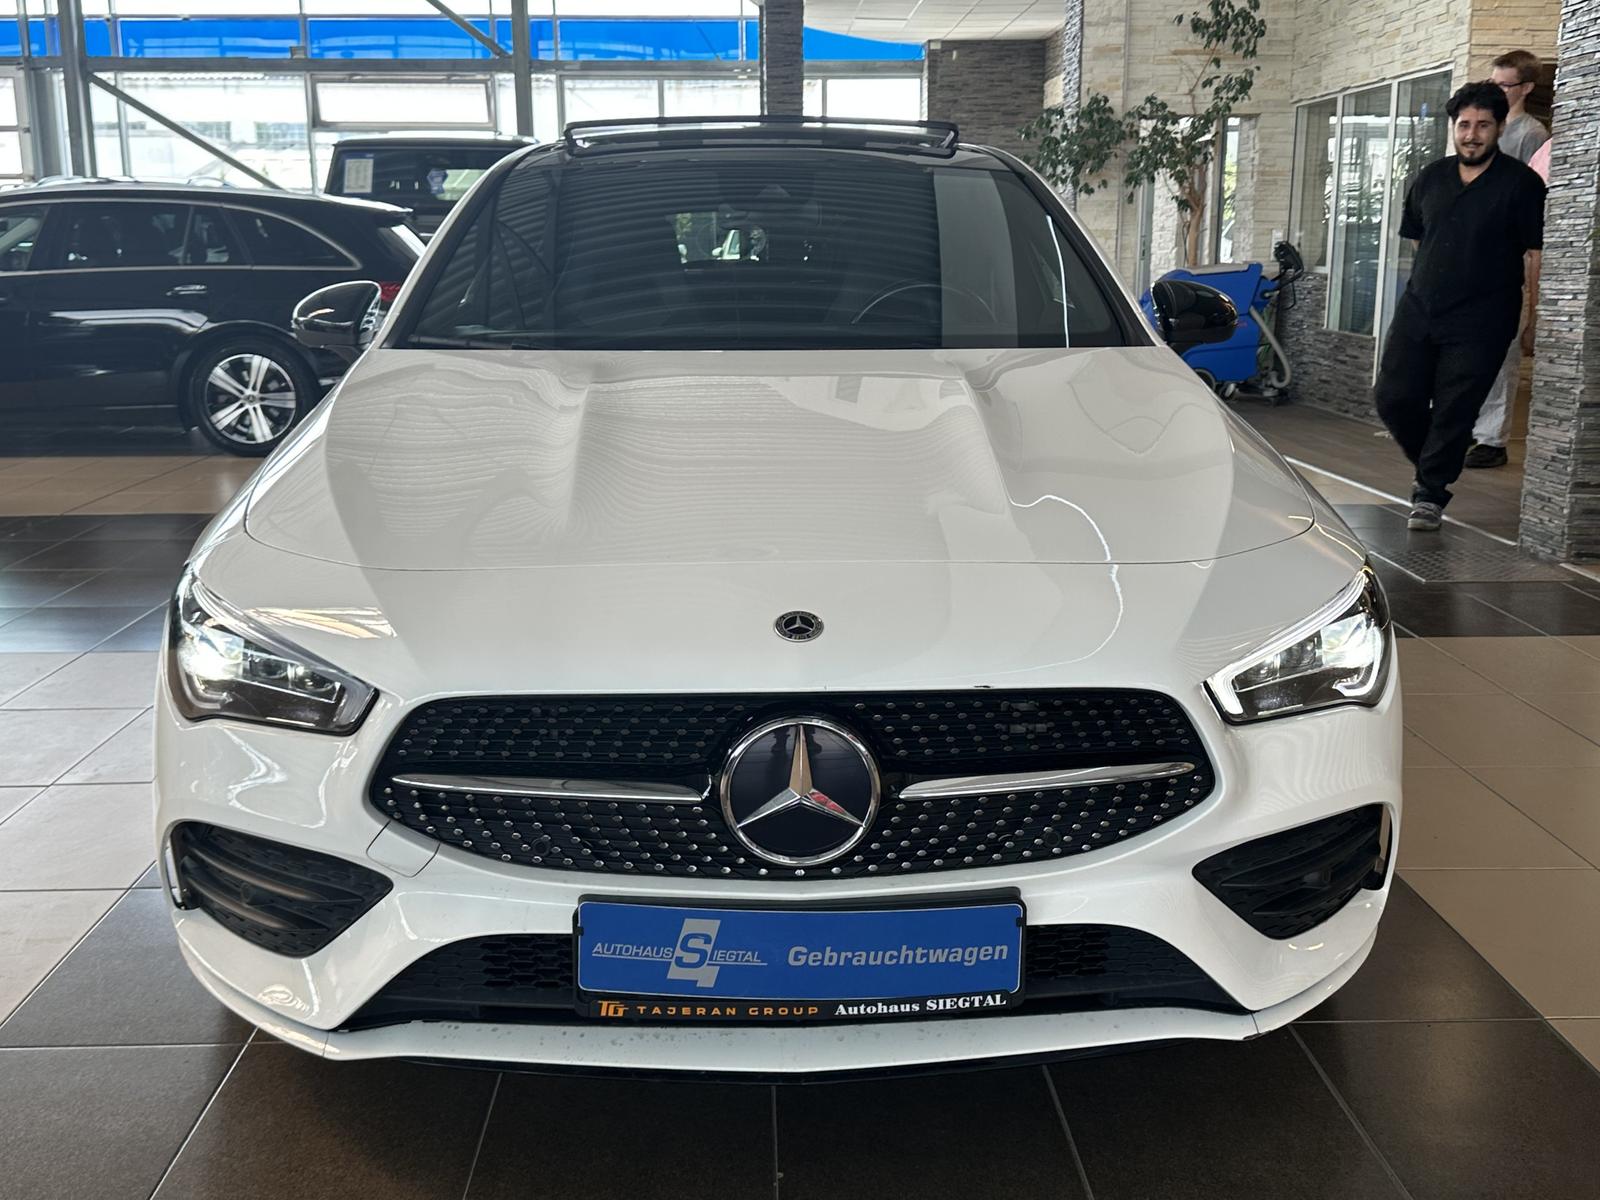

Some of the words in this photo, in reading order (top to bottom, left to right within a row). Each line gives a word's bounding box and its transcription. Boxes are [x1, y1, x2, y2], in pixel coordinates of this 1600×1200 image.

[592, 942, 673, 960] AUTOHAUS
[787, 944, 1009, 967] Gebrauchtwagen
[637, 1006, 737, 1016] TAJERAN
[748, 1005, 819, 1016] GROUP
[834, 1002, 920, 1016] Autohaus
[926, 993, 1007, 1011] SIEGTAL
